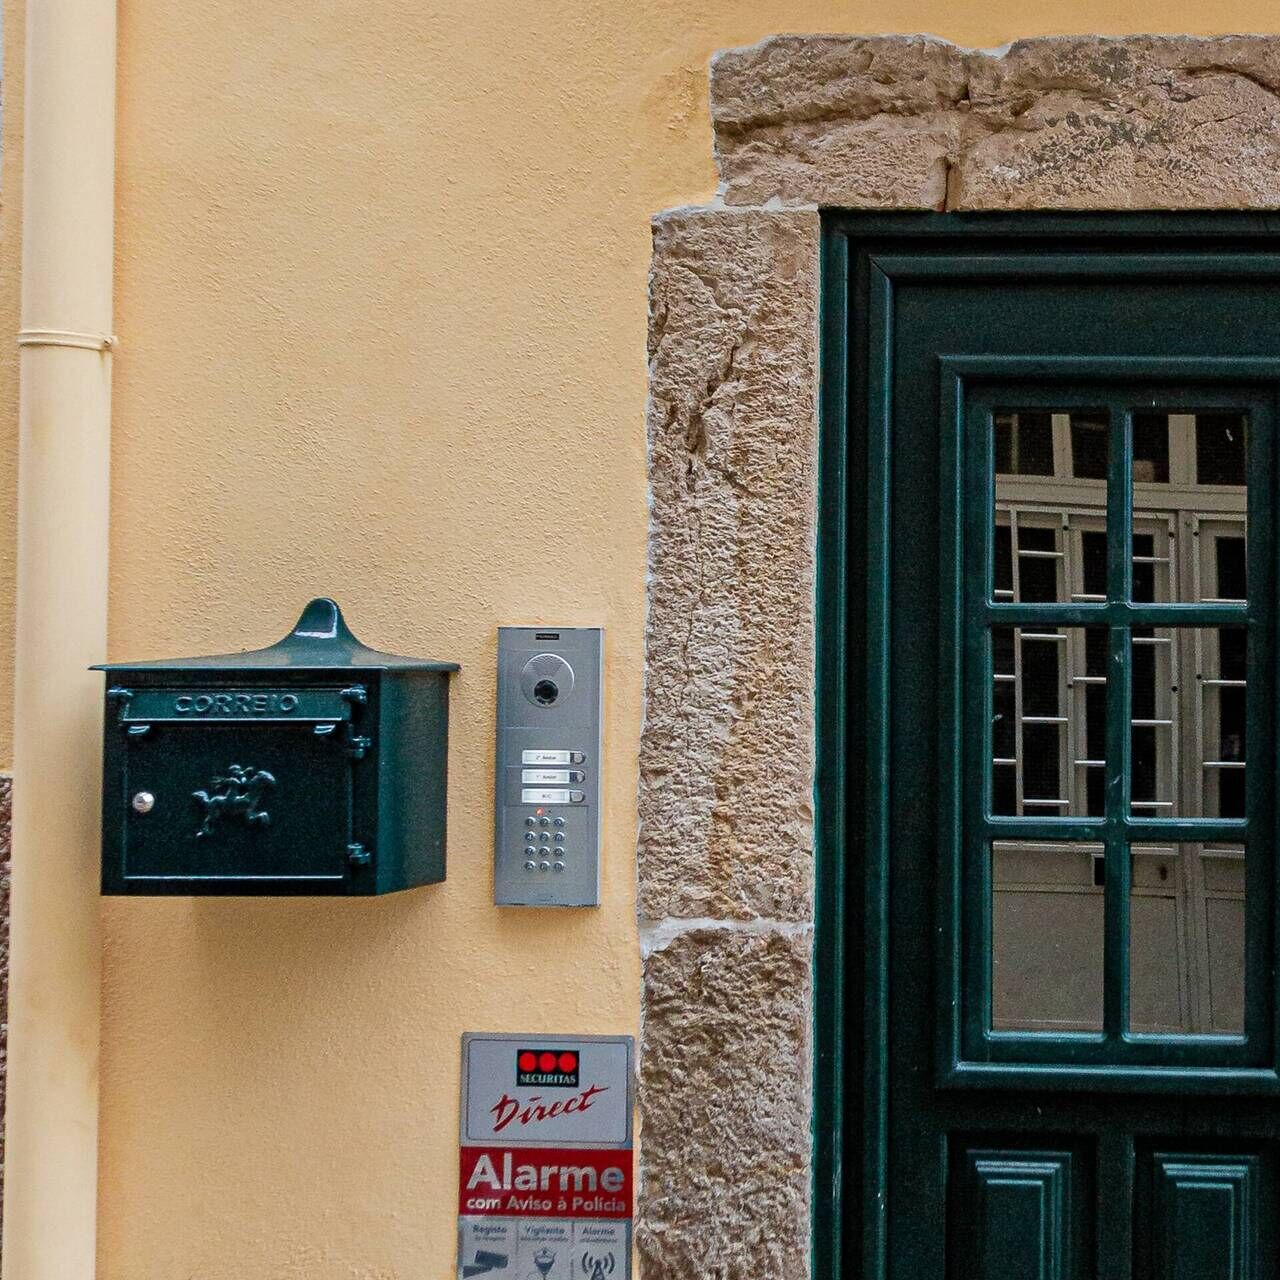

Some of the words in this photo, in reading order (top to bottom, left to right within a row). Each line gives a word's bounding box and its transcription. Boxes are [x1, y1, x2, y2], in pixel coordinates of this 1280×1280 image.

[175, 693, 299, 713] CORREIO
[520, 1073, 576, 1084] SECURITAS
[490, 1084, 609, 1132] Direct
[466, 1152, 625, 1192] Alarme
[466, 1197, 499, 1209] com
[506, 1195, 552, 1210] Aviso
